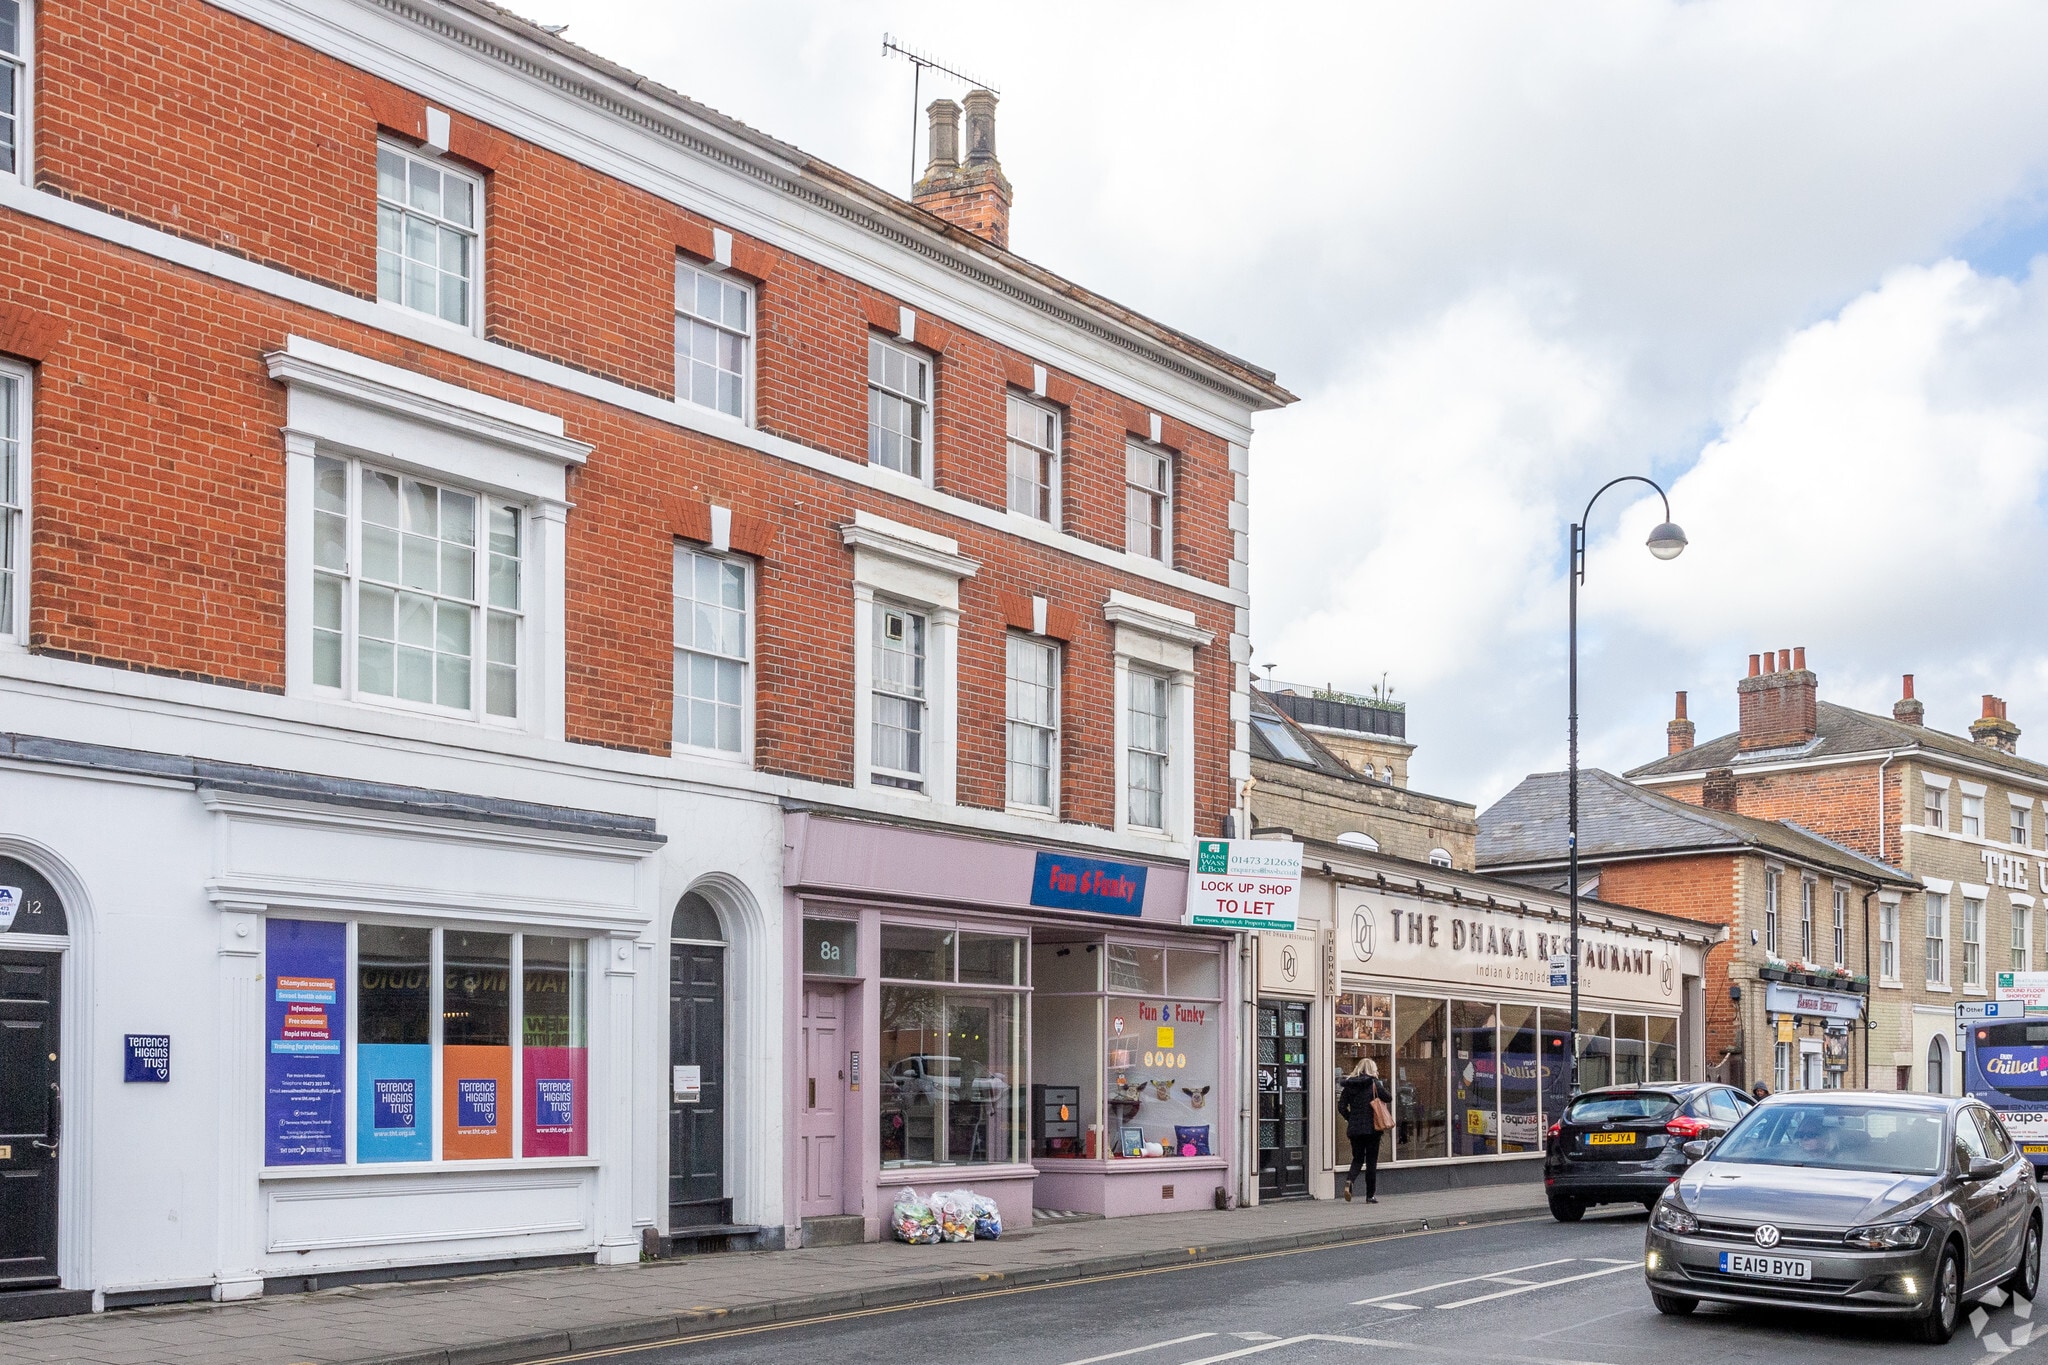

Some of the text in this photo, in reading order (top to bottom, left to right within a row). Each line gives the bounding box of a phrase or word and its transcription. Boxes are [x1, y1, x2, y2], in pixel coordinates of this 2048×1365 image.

[1231, 855, 1299, 867] 01473 212656
[1981, 849, 2028, 891] THE
[1049, 865, 1077, 893] Fun
[1093, 870, 1136, 903] Funky
[1201, 881, 1292, 895] LOCK UP SHOP
[27, 900, 42, 914] 12
[1216, 899, 1275, 915] TO LET
[1220, 918, 1237, 926] Agents
[1391, 908, 1439, 948] THE
[1452, 918, 1528, 959] DHAKA
[821, 941, 839, 960] 8a
[1476, 963, 1503, 978] Indian
[1506, 967, 1511, 978] &
[280, 979, 333, 989] Chlamydia screening
[291, 1005, 322, 1013] Information
[1139, 1001, 1157, 1021] Fun
[1175, 1003, 1205, 1025] Funky
[1987, 1004, 1996, 1015] P
[311, 1031, 329, 1039] testing
[274, 1043, 295, 1051] Training
[135, 1048, 168, 1058] HIGGINS
[143, 1058, 168, 1068] TRUST
[1986, 1057, 2039, 1075] Chilled
[382, 1093, 413, 1103] HIGGINS
[466, 1093, 494, 1102] HIGGINS
[544, 1093, 570, 1102] HIGGINS
[390, 1103, 413, 1113] TRUST
[473, 1103, 494, 1112] TRUST
[551, 1102, 570, 1111] TRUST
[1593, 1133, 1631, 1142] FD15 JYA
[1733, 1256, 1768, 1273] EA19
[1773, 1260, 1805, 1277] BYD
